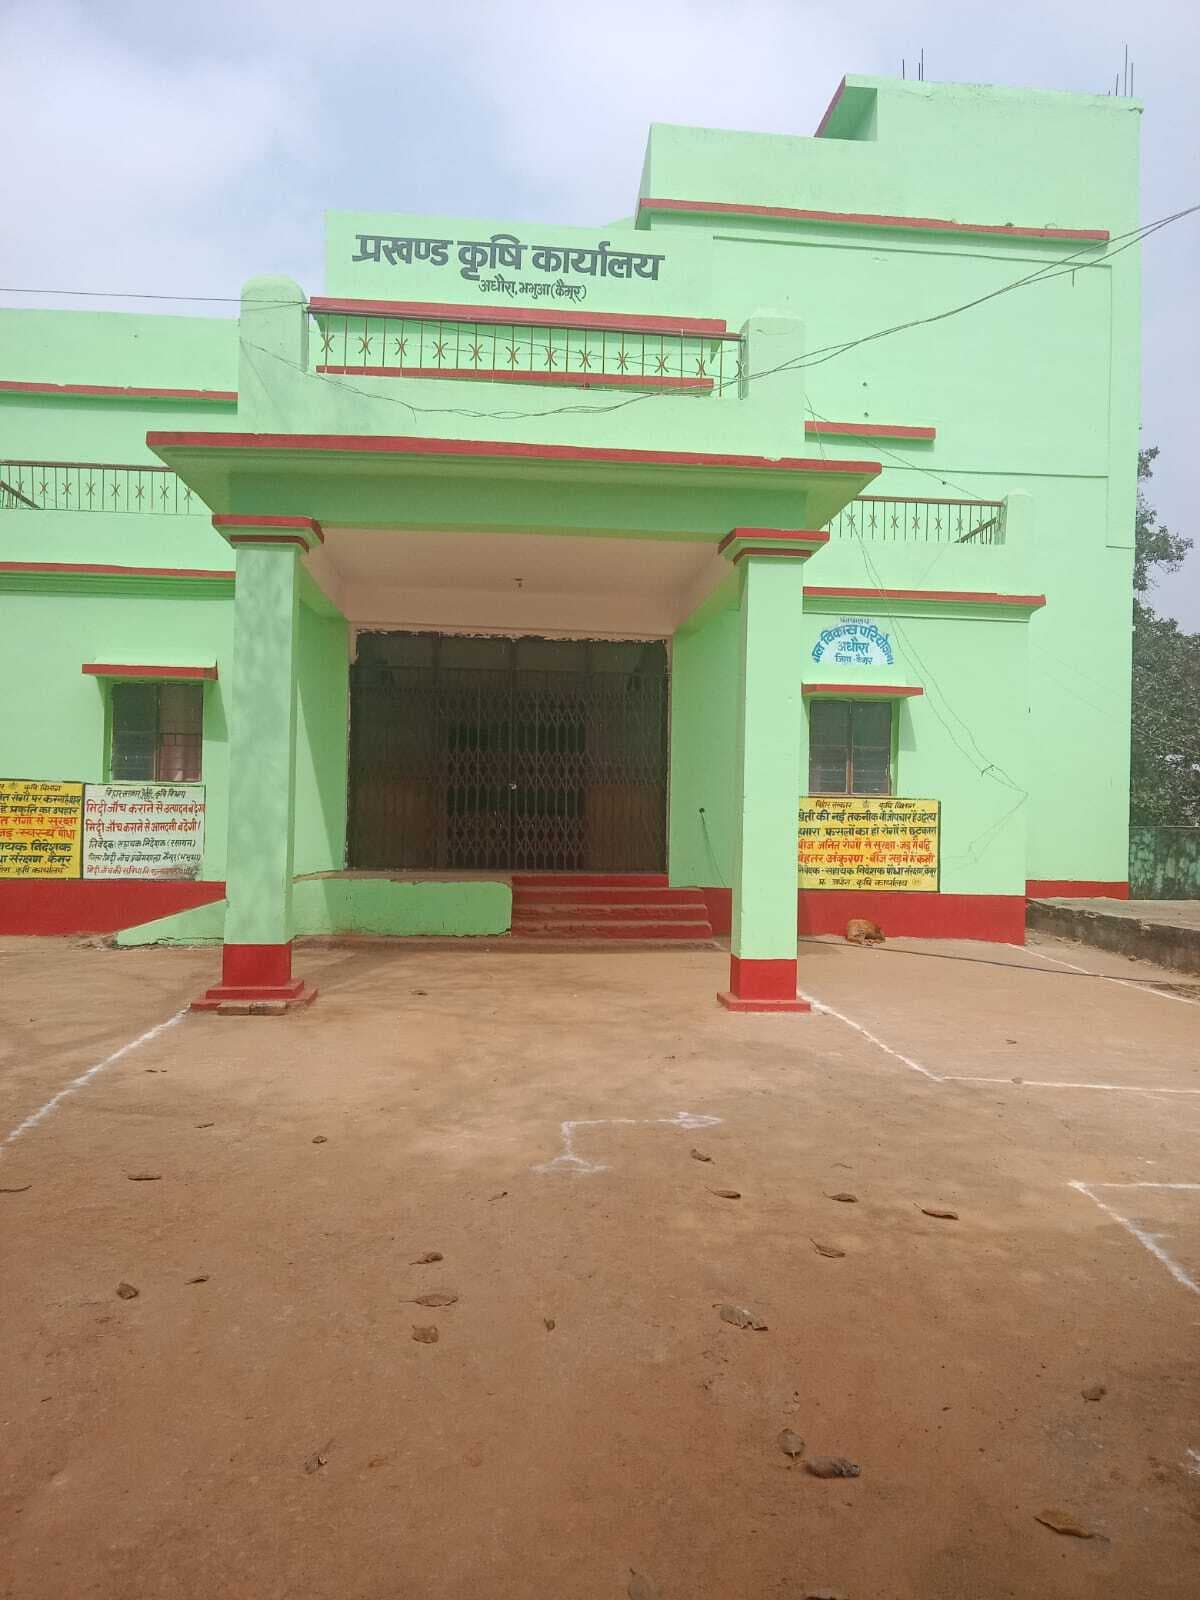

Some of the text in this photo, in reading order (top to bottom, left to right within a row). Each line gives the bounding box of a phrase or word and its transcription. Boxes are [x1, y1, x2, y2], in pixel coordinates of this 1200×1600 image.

[351, 233, 665, 281] प्रखण्ड कृषि कार्यालय
[816, 809, 831, 822] की
